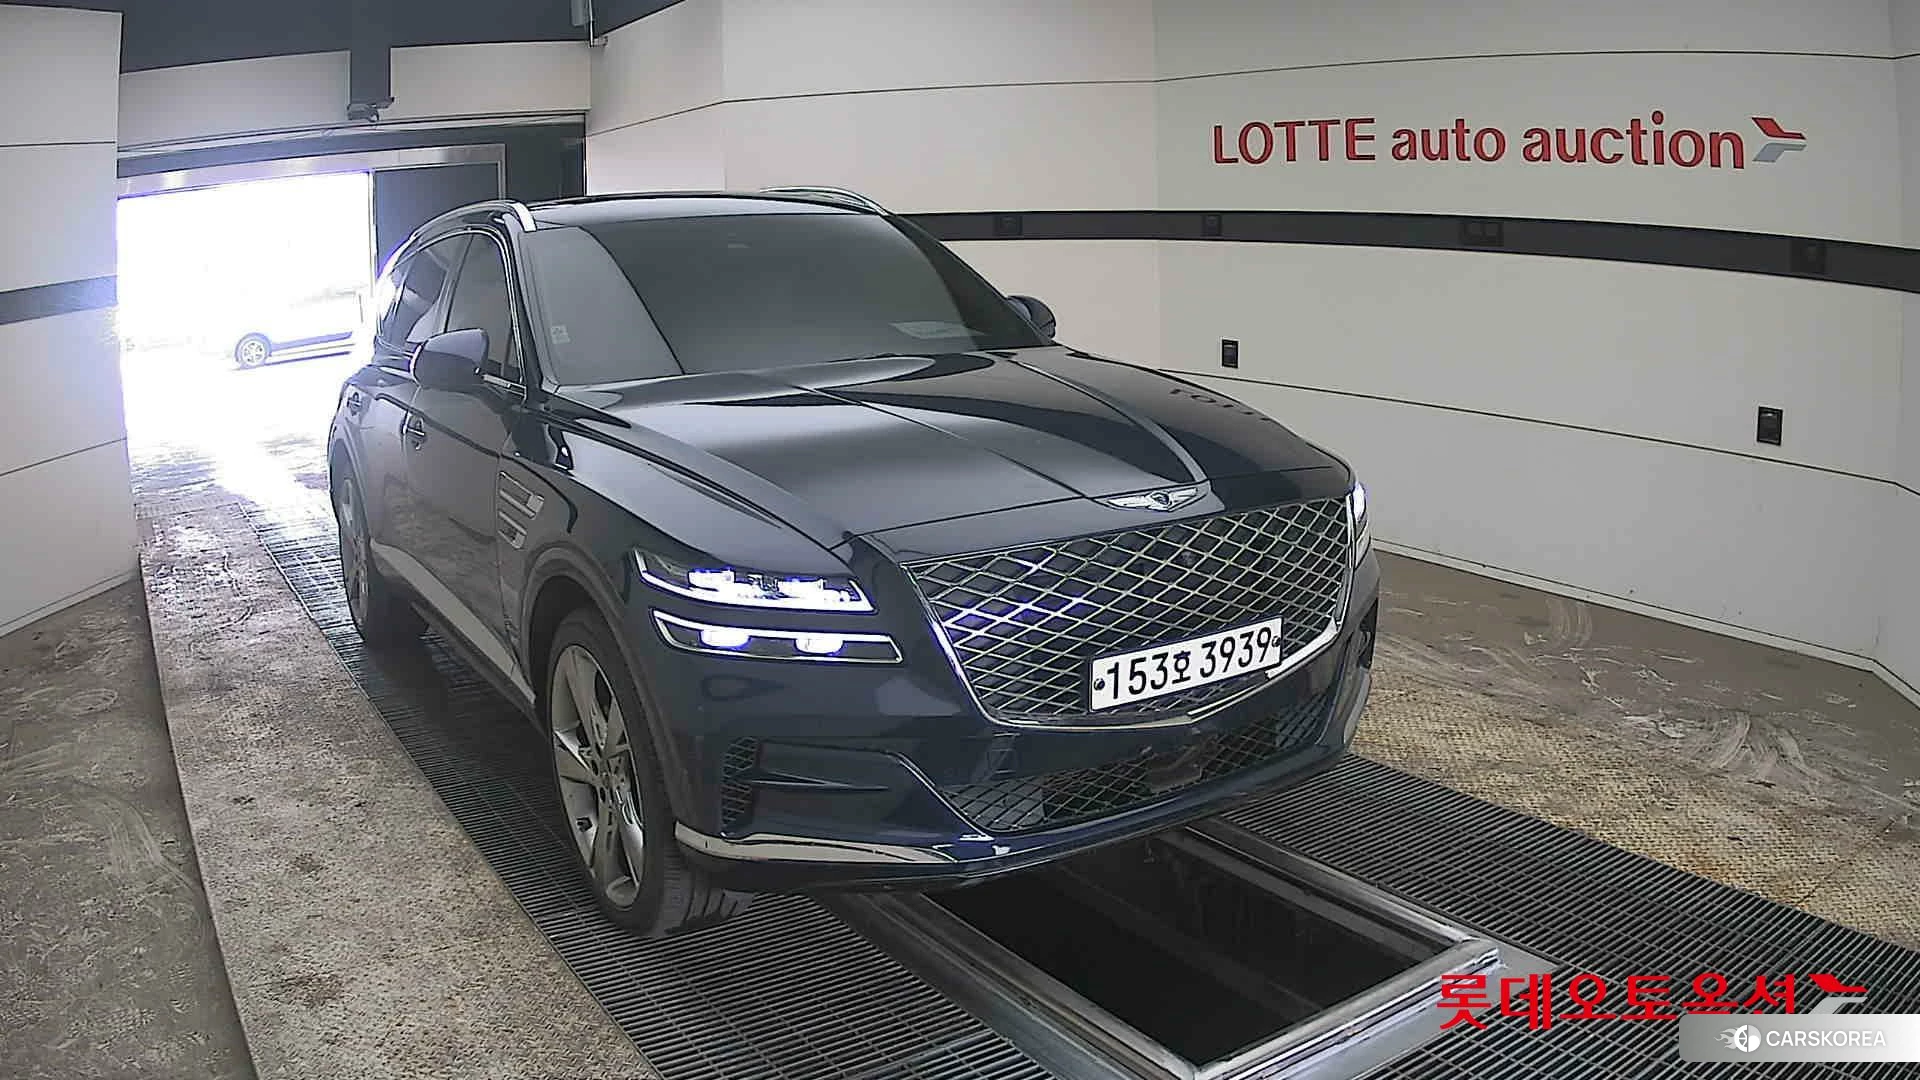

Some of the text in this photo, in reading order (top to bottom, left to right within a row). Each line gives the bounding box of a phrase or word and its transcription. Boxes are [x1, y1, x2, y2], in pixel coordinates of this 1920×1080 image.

[1213, 111, 1745, 170] LOTTE auto auction
[1107, 626, 1272, 699] 153호 3939
